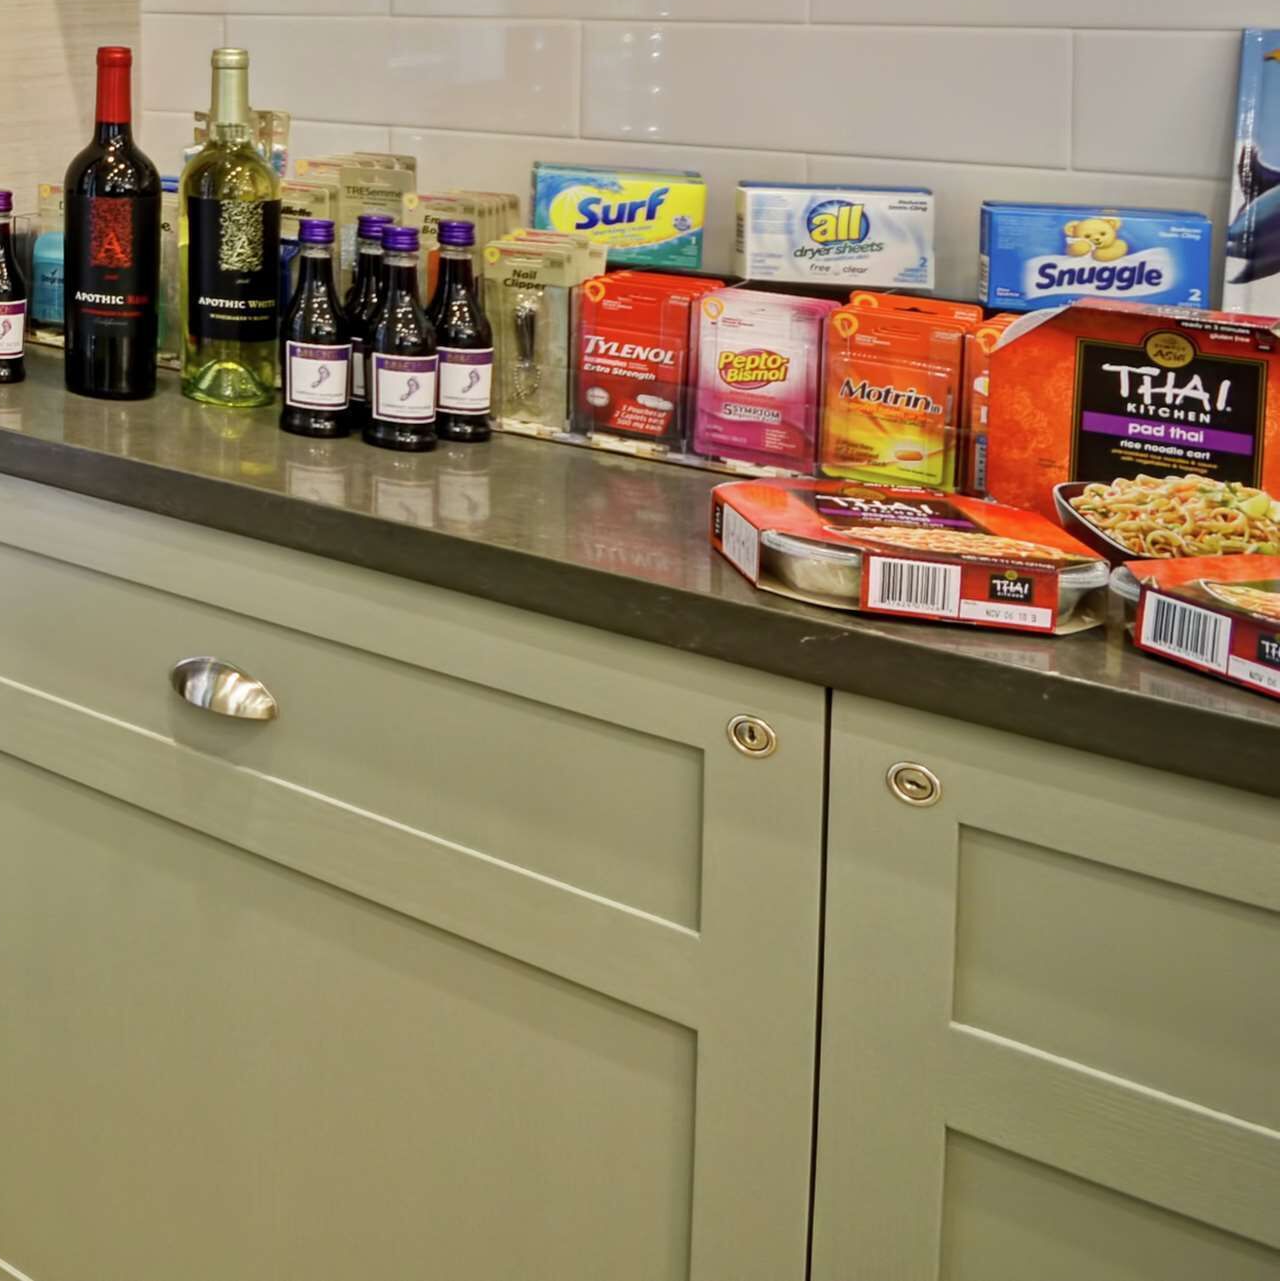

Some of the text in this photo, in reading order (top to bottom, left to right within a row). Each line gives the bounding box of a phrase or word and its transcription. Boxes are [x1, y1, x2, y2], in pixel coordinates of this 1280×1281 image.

[575, 187, 670, 230] Surf
[809, 203, 865, 244] all
[793, 241, 885, 260] dryer sheets
[512, 269, 537, 280] Nail
[810, 263, 868, 274] free clear
[1036, 260, 1163, 291] Snuggle
[504, 278, 546, 291] Clipper
[75, 290, 125, 305] APOTHIC
[198, 296, 275, 309] APOTHIC WHITE
[1188, 289, 1201, 302] 2
[1181, 321, 1203, 330] ready
[1220, 325, 1251, 334] minutes
[583, 334, 676, 364] TYLENOL
[611, 366, 656, 380] Strength
[726, 365, 789, 383] Bismol
[840, 377, 932, 411] Motrin
[1101, 363, 1232, 412] THAI
[733, 405, 780, 418] SYMPTOM
[1127, 402, 1212, 424] KITCHEN
[1128, 420, 1204, 443] pad thai
[1120, 439, 1211, 461] rice noodle cart
[816, 494, 934, 515] THAI
[992, 578, 1030, 596] THAI
